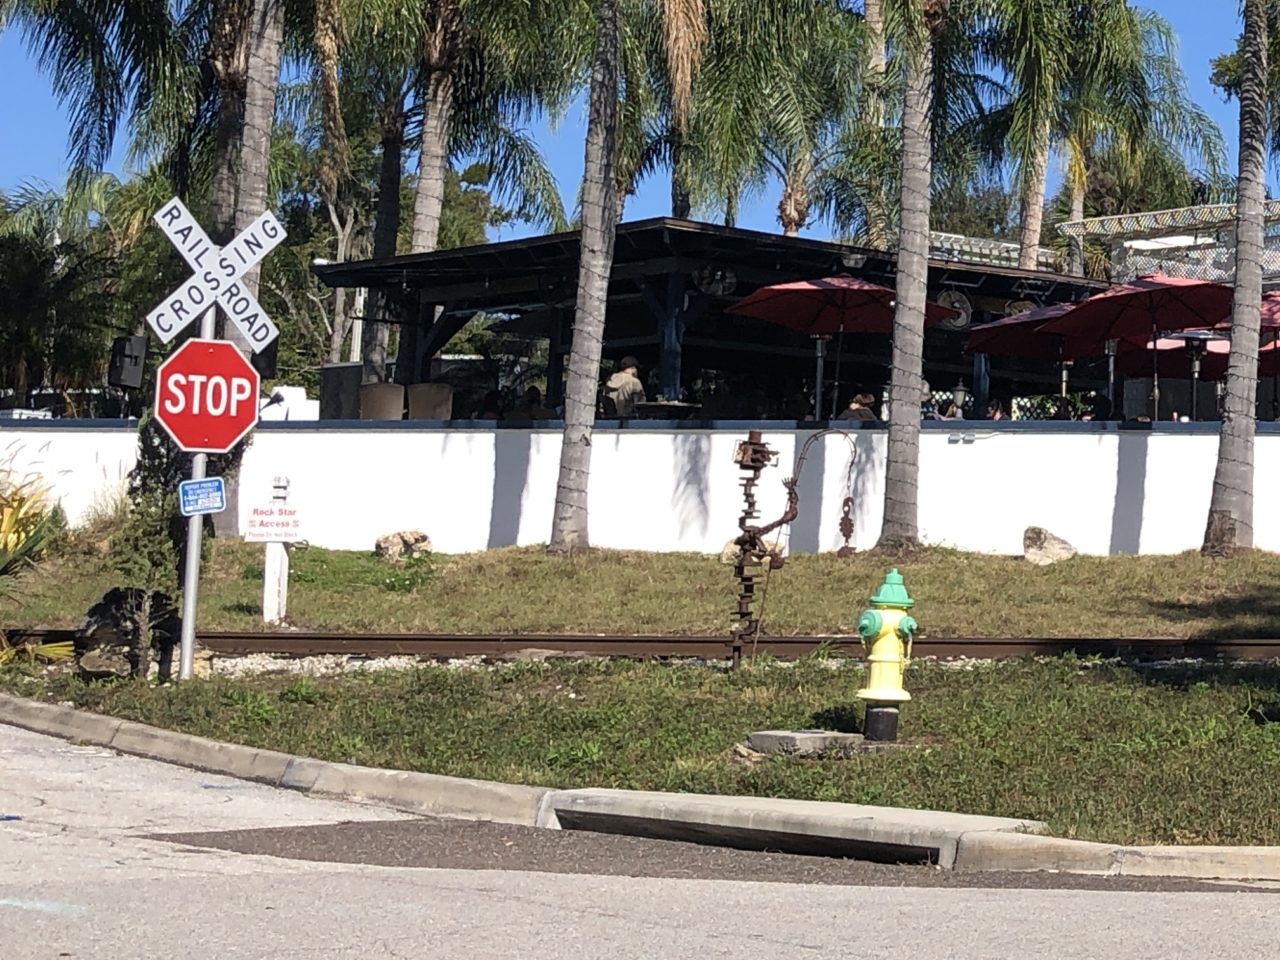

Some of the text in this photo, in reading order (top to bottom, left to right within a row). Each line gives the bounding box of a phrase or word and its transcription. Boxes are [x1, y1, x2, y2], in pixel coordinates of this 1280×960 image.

[155, 219, 279, 334] CROSSING
[164, 372, 252, 417] STOP
[259, 519, 290, 528] Access
